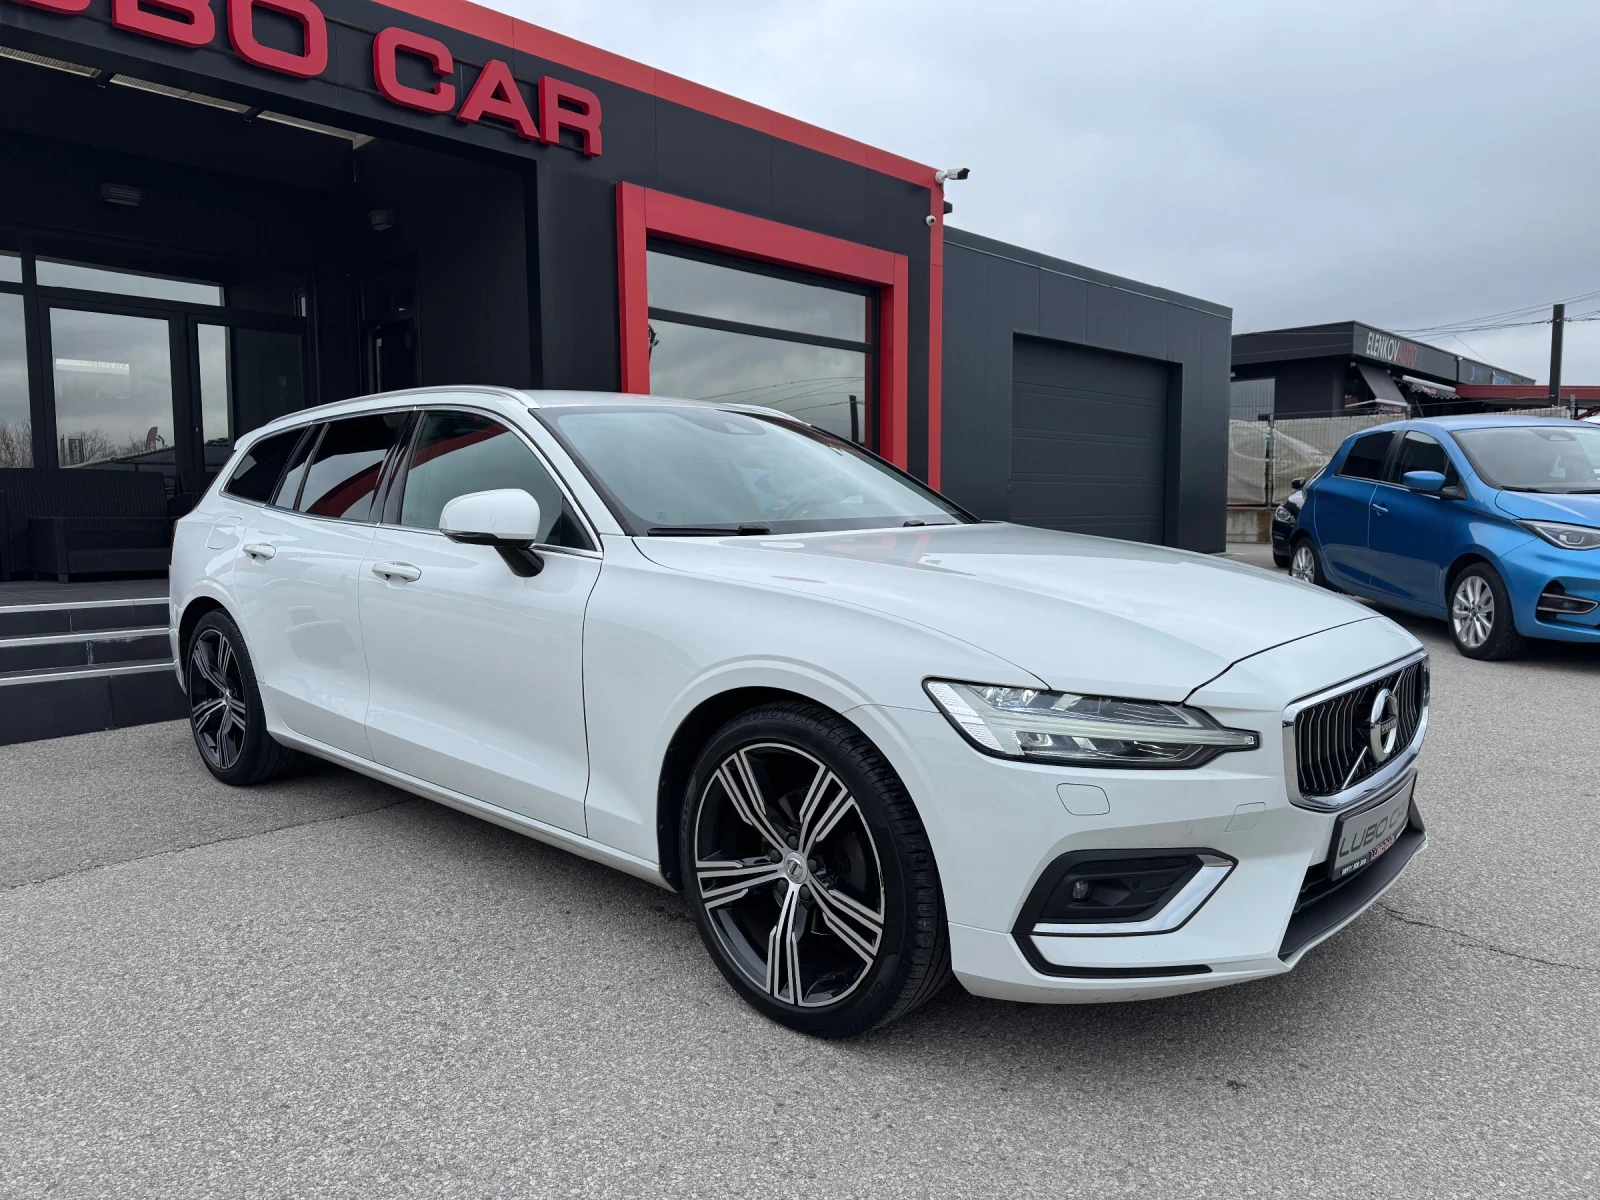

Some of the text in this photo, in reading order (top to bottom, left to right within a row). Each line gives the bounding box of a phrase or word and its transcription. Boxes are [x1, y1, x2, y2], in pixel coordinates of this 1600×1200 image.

[0, 0, 602, 157] BO CAR
[1339, 816, 1388, 857] LUBO
